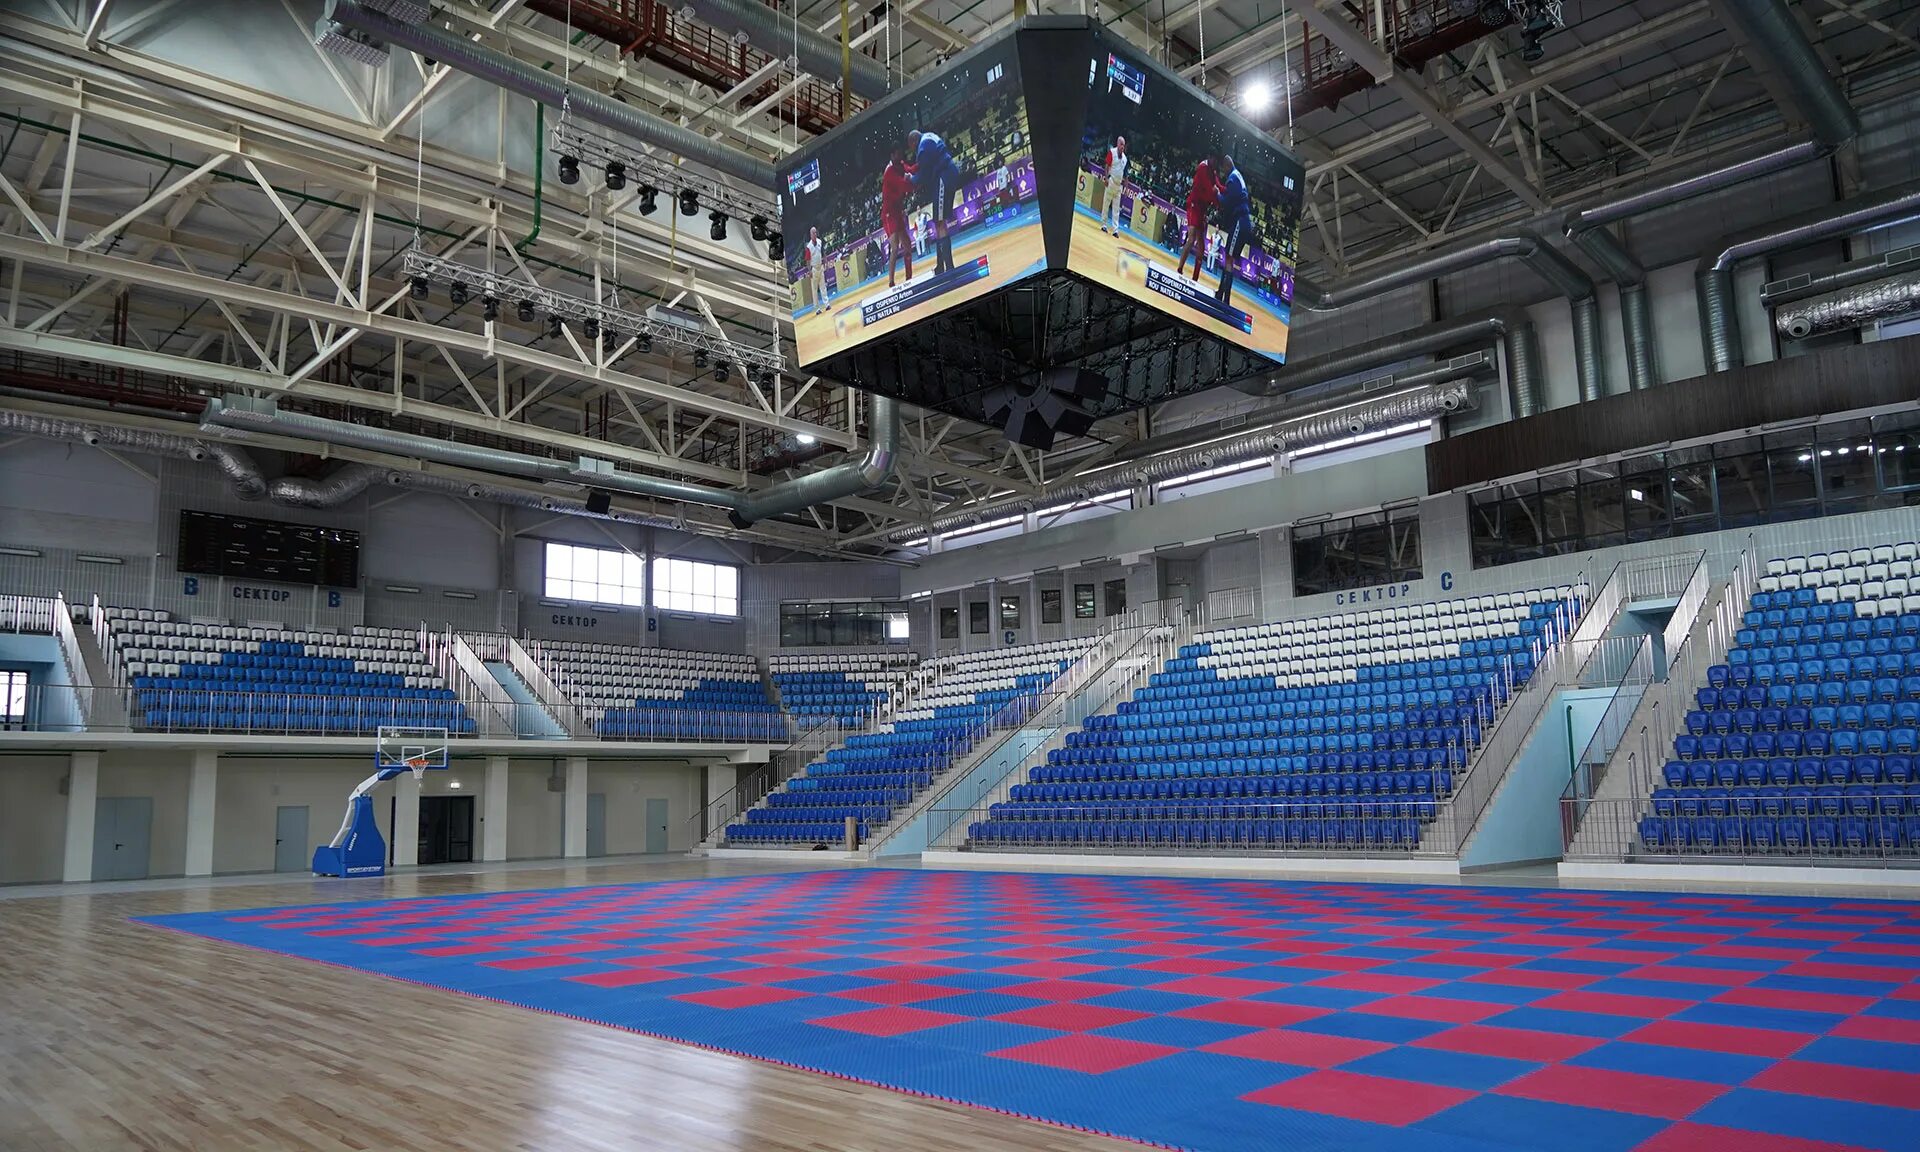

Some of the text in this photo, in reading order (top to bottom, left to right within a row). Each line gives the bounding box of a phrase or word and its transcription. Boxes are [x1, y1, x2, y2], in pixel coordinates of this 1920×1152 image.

[1148, 281, 1159, 291] ROU
[1150, 271, 1159, 280] RSF
[1182, 286, 1196, 297] Artem
[865, 306, 874, 314] RSF
[899, 290, 913, 300] Artem
[865, 315, 876, 325] ROU
[233, 586, 290, 602] СЕКТОР
[1336, 584, 1409, 605] СЕКТОР
[552, 614, 597, 628] СЕКТОР
